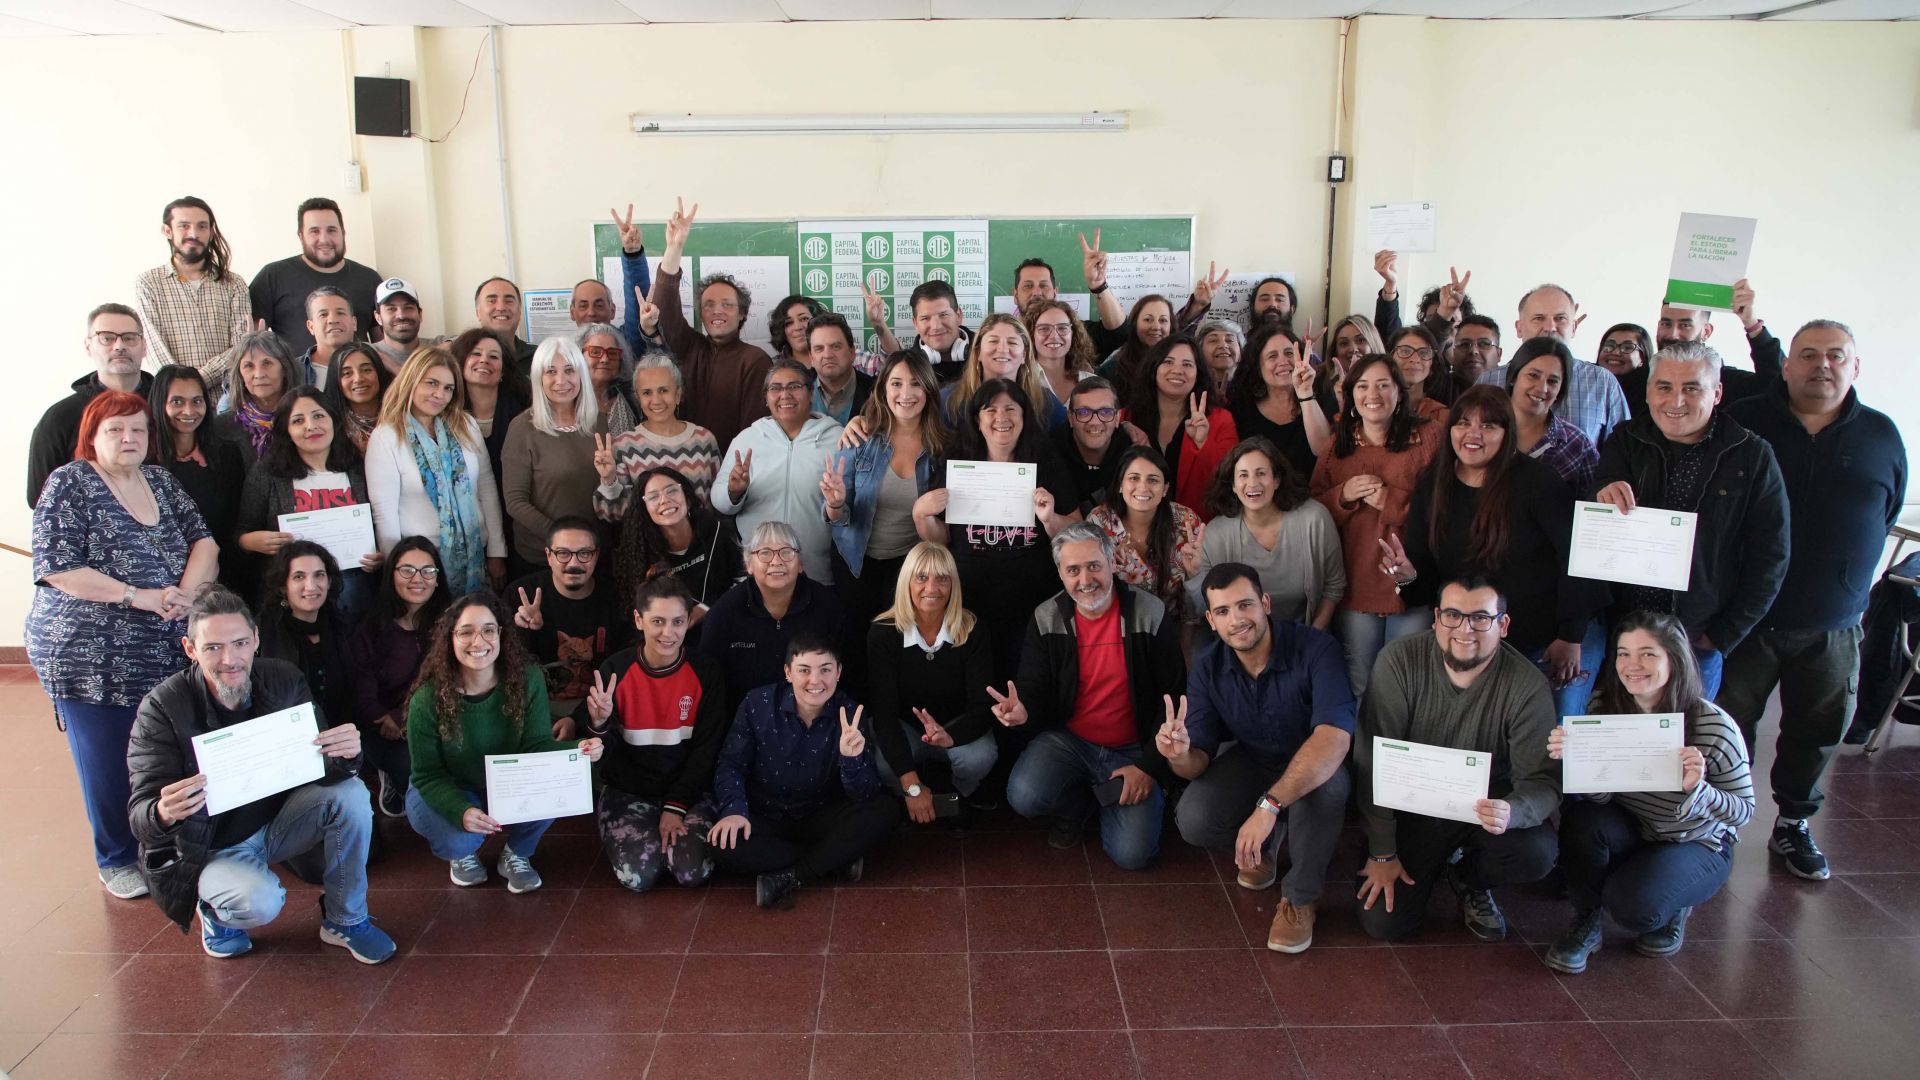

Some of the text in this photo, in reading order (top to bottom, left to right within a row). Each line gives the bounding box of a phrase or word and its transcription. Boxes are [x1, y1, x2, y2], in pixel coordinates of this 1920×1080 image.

[1692, 233, 1737, 243] FORTALECER
[834, 240, 859, 248] CAPITAL
[896, 239, 920, 247] CAPITAL
[1700, 240, 1728, 249] ESTADO
[834, 248, 861, 256] FEDERAL
[896, 247, 922, 255] FEDERAL
[1689, 246, 1738, 257] PARA LIBERAR
[835, 272, 860, 280] CAPITAL
[957, 271, 982, 279] CAPITAL
[835, 280, 861, 288] FEDERAL
[957, 279, 983, 287] FEDERAL
[836, 305, 860, 313] CAPITAL
[897, 304, 912, 312] CAPI
[844, 313, 862, 321] DERAL
[897, 312, 913, 320] FEDE
[962, 311, 983, 319] EDERAL
